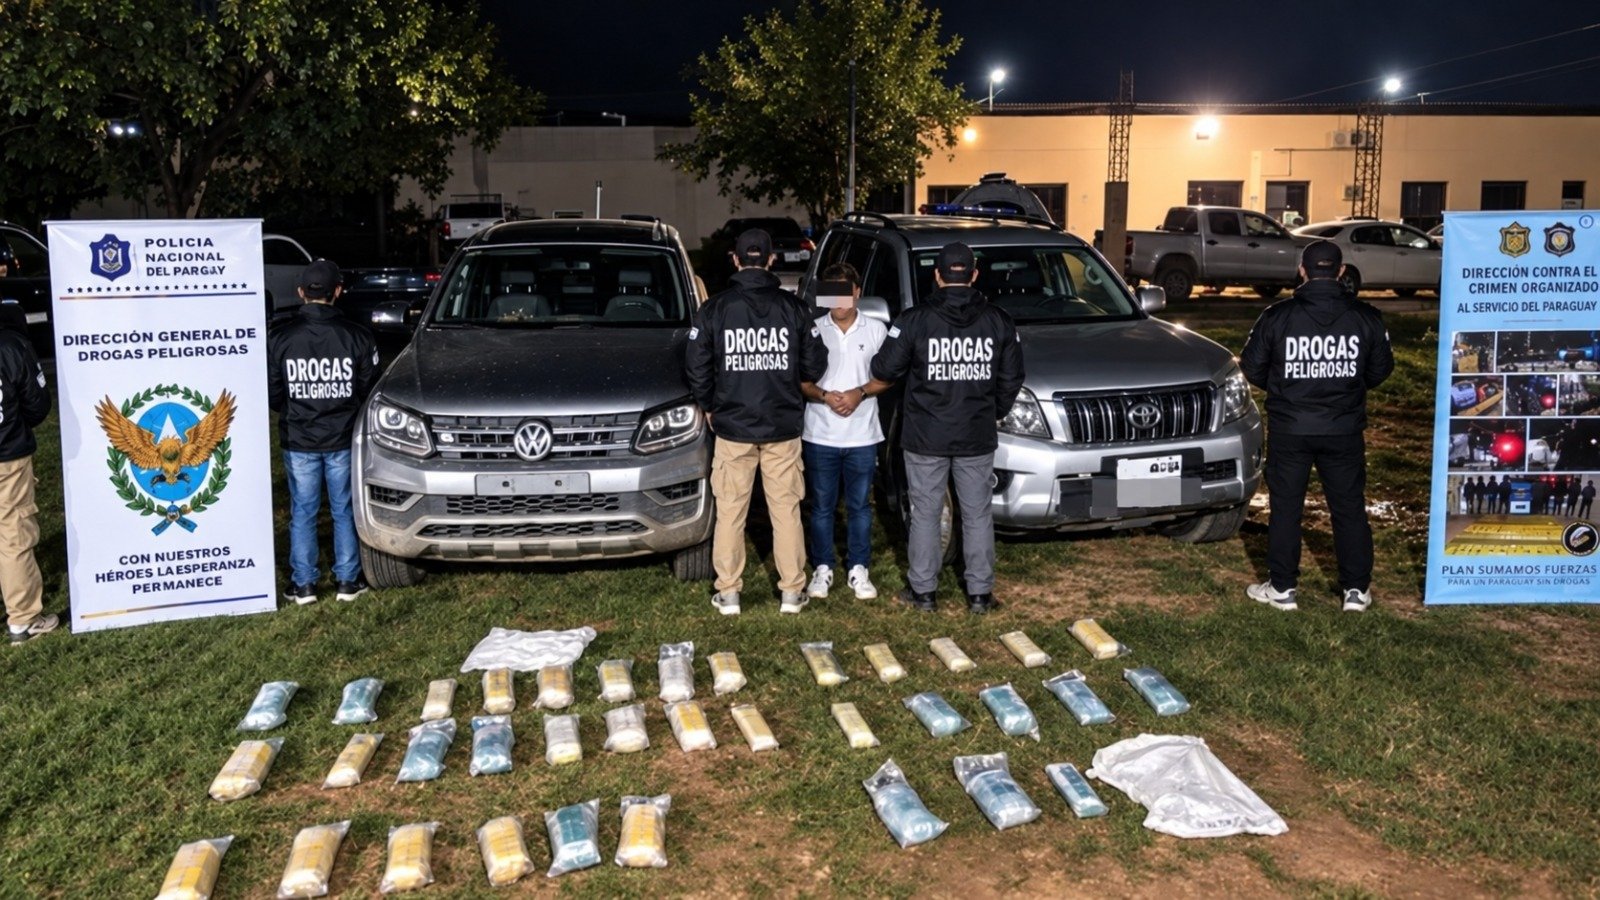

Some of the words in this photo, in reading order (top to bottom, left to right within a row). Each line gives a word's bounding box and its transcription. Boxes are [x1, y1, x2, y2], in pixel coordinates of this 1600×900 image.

[144, 237, 214, 248] POLICIA
[145, 252, 225, 262] NACIONAL
[146, 266, 171, 277] DEL
[1462, 264, 1529, 279] DIRECCIÓN
[1532, 266, 1581, 278] CONTRA
[1584, 266, 1597, 277] EL
[1468, 282, 1517, 294] CRIMEN
[1521, 281, 1599, 294] ORGANIZADO
[1457, 302, 1470, 313] AL
[1472, 301, 1519, 313] SERVICIO
[1521, 301, 1540, 312] DEL
[1542, 300, 1597, 312] PARAGUAY
[63, 330, 153, 346] DIRECCIÓN
[158, 328, 232, 342] GENERAL
[235, 327, 257, 339] DE
[724, 327, 789, 354] DROGAS
[78, 348, 144, 362] DROGAS
[148, 344, 249, 359] PELIGROSAS
[928, 337, 994, 363] DROGAS
[1285, 335, 1360, 361] DROGAS
[286, 357, 353, 382] DROGAS
[725, 353, 788, 371] PELIGROSAS
[1284, 361, 1357, 379] PELIGROSAS
[928, 363, 992, 381] PELIGROSAS
[288, 381, 352, 399] PELIGROSAS
[118, 553, 151, 566] CON
[155, 546, 231, 562] NUESTROS
[95, 568, 153, 583] HÉROES
[157, 566, 174, 577] LA
[176, 558, 256, 575] ESPERANZA
[1442, 565, 1475, 575] PLAN
[1478, 564, 1541, 575] SUMAMOS
[1545, 564, 1597, 574] FUERZAS
[132, 576, 223, 594] PERMANECE
[1447, 578, 1471, 586] PARA
[1473, 578, 1486, 586] UN
[1553, 577, 1590, 585] DROGAS
